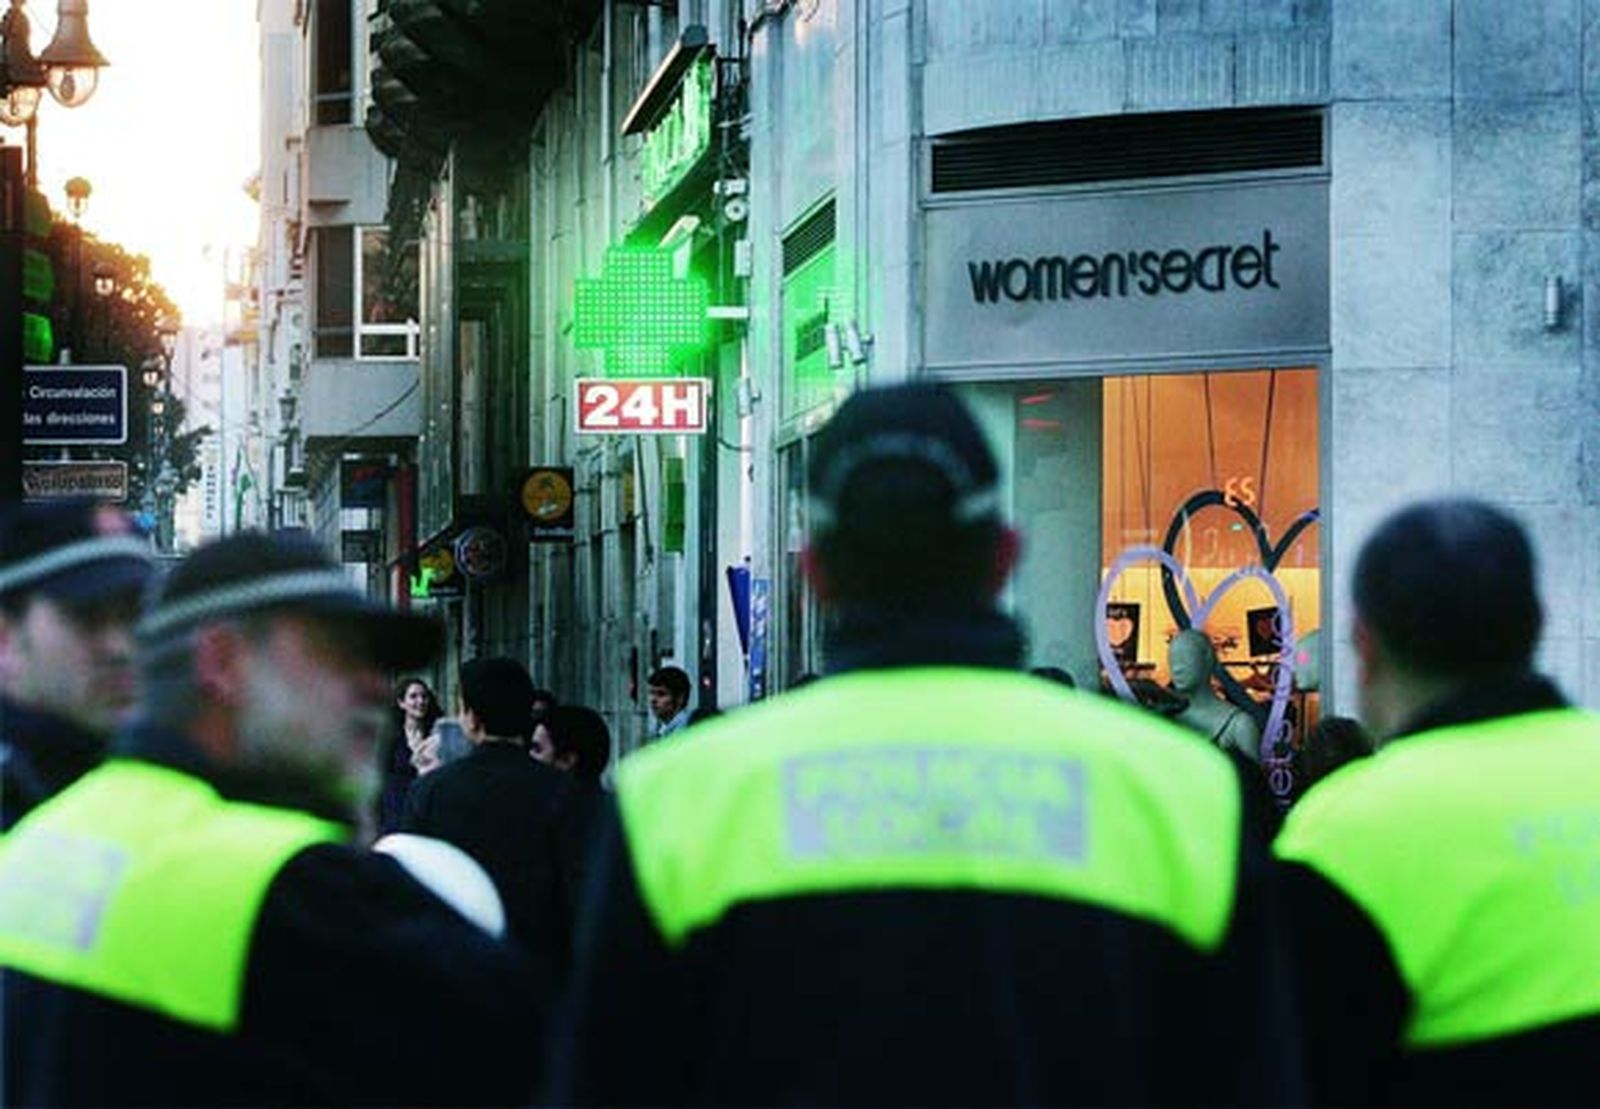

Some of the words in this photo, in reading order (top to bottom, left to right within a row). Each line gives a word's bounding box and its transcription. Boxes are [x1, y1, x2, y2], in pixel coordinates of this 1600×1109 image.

[967, 229, 1280, 304] women'secret
[46, 411, 117, 425] direcciones
[584, 385, 699, 426] 24H
